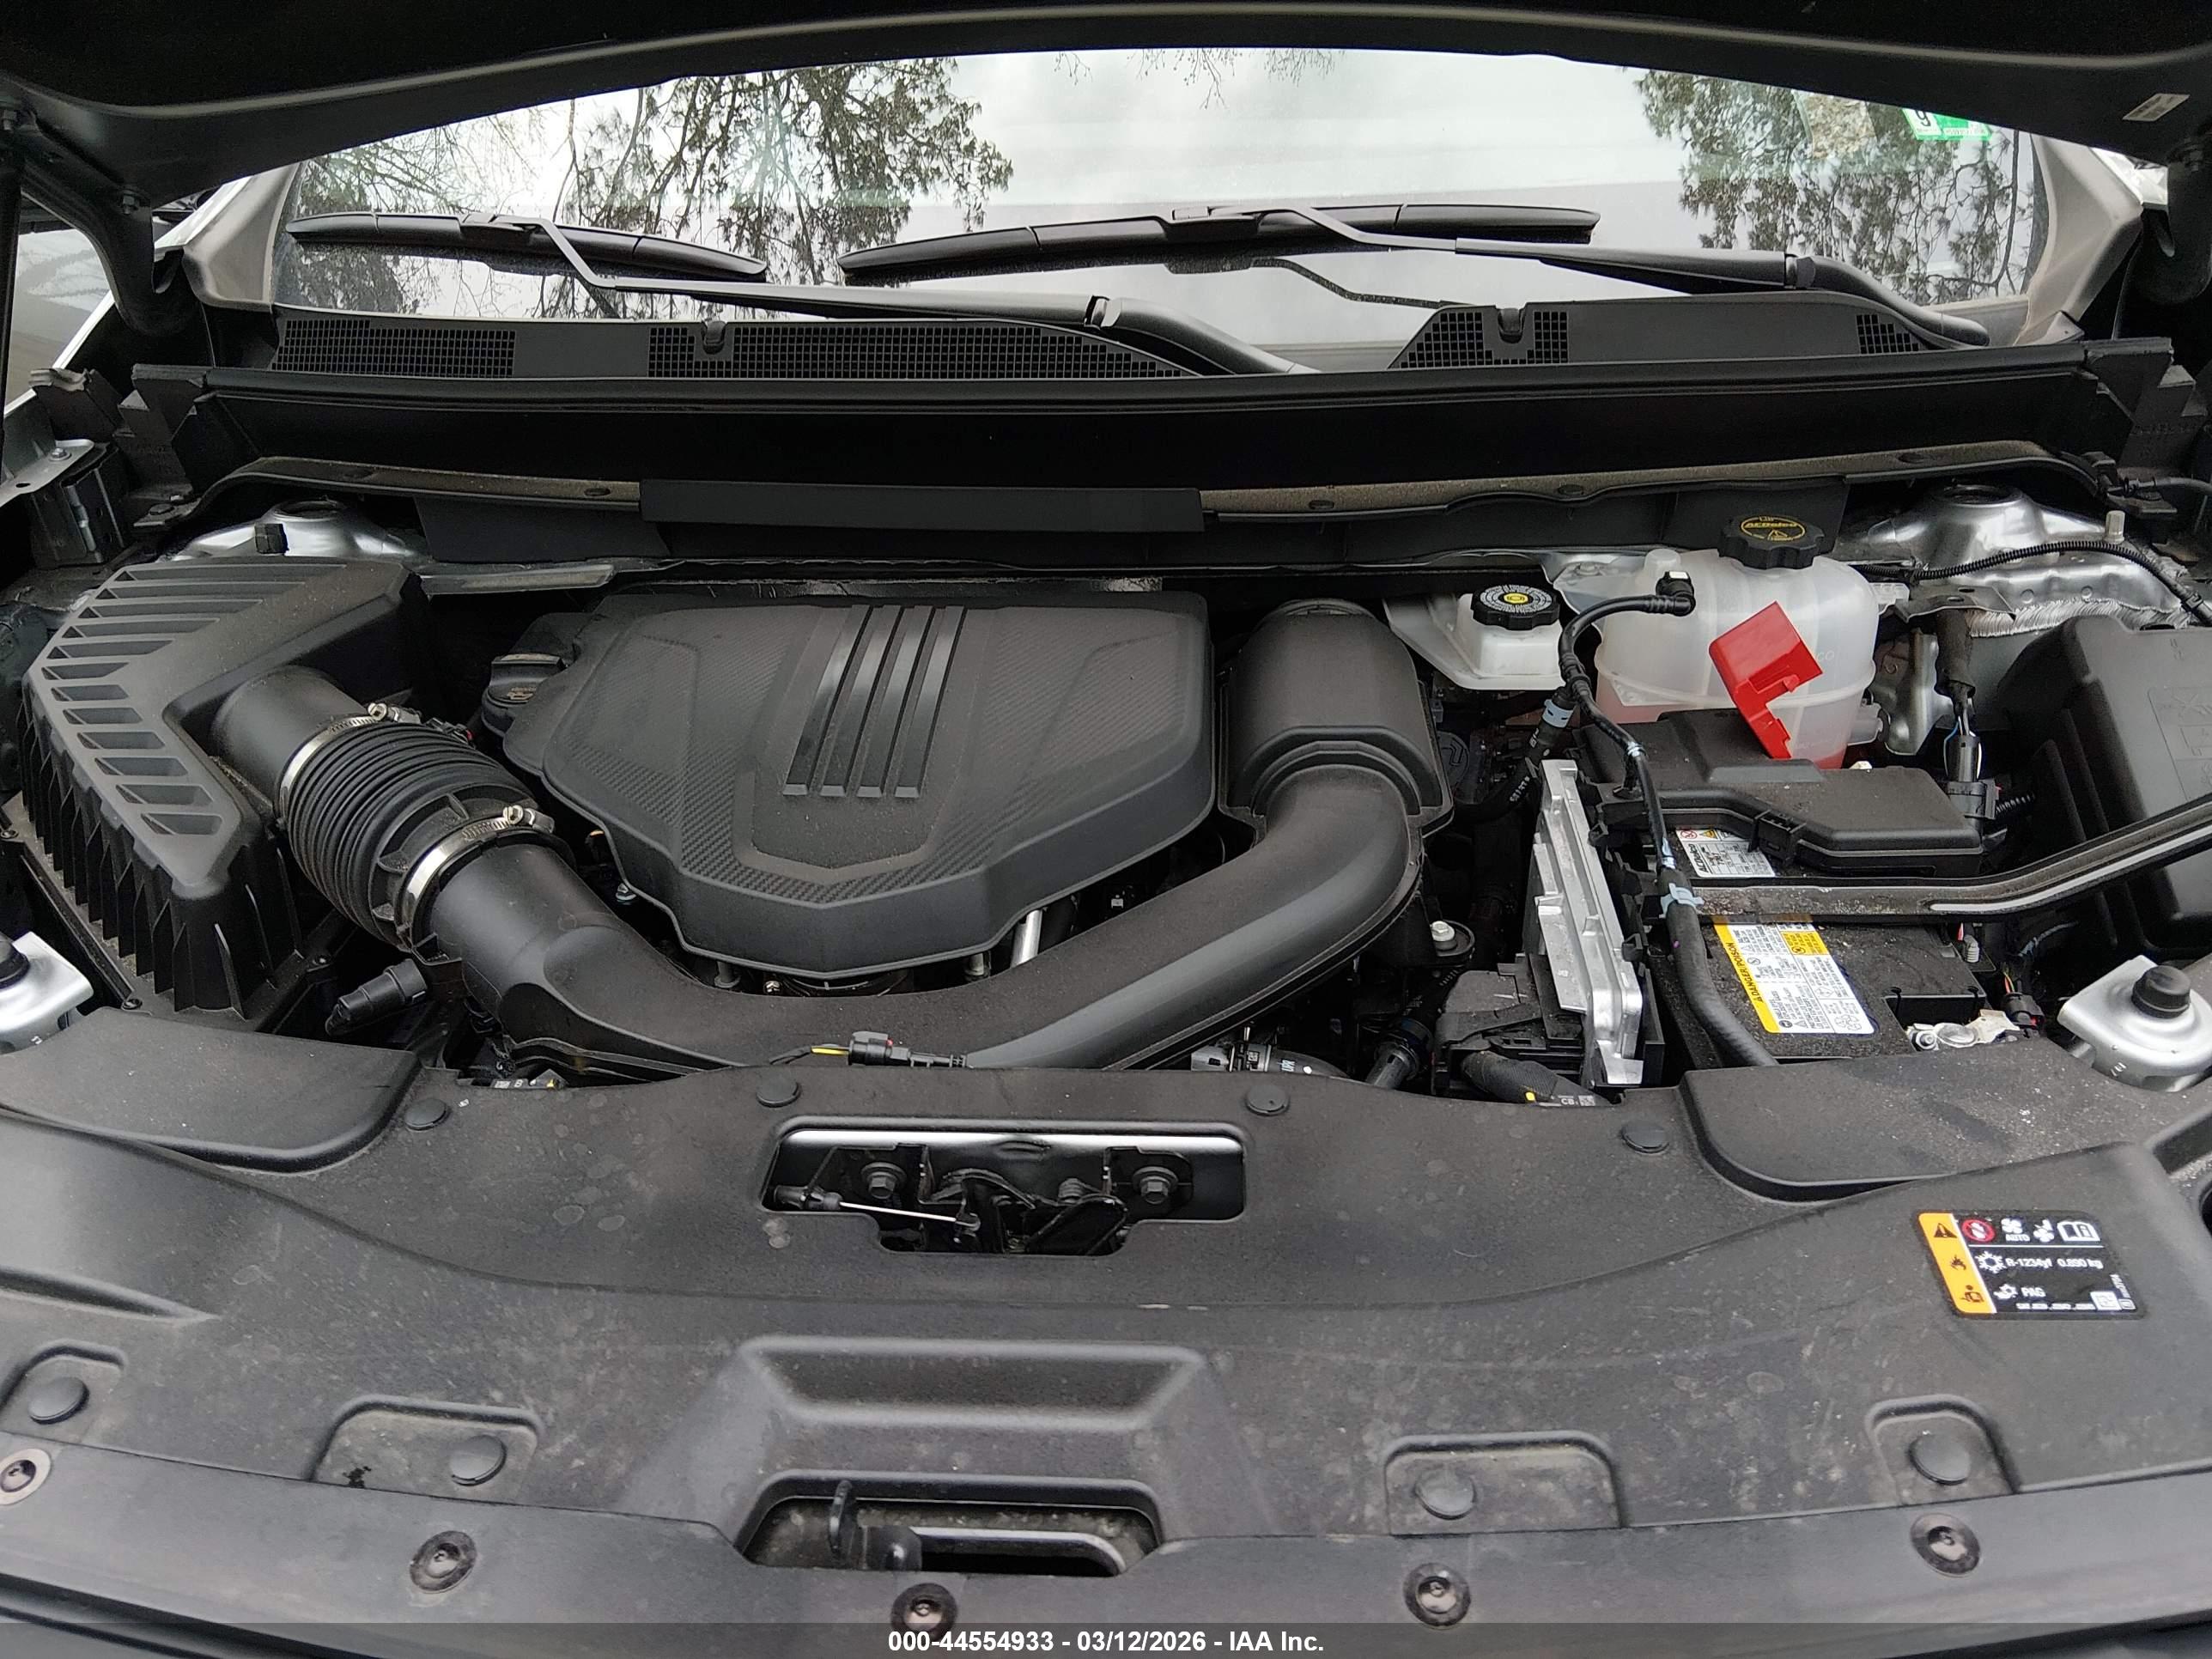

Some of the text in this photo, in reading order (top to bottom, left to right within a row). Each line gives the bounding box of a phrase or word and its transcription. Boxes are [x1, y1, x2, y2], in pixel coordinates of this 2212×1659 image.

[1687, 843, 1709, 873] ACDelco
[2005, 1258, 2053, 1269] R-1234yf
[2021, 1286, 2046, 1297] PAG
